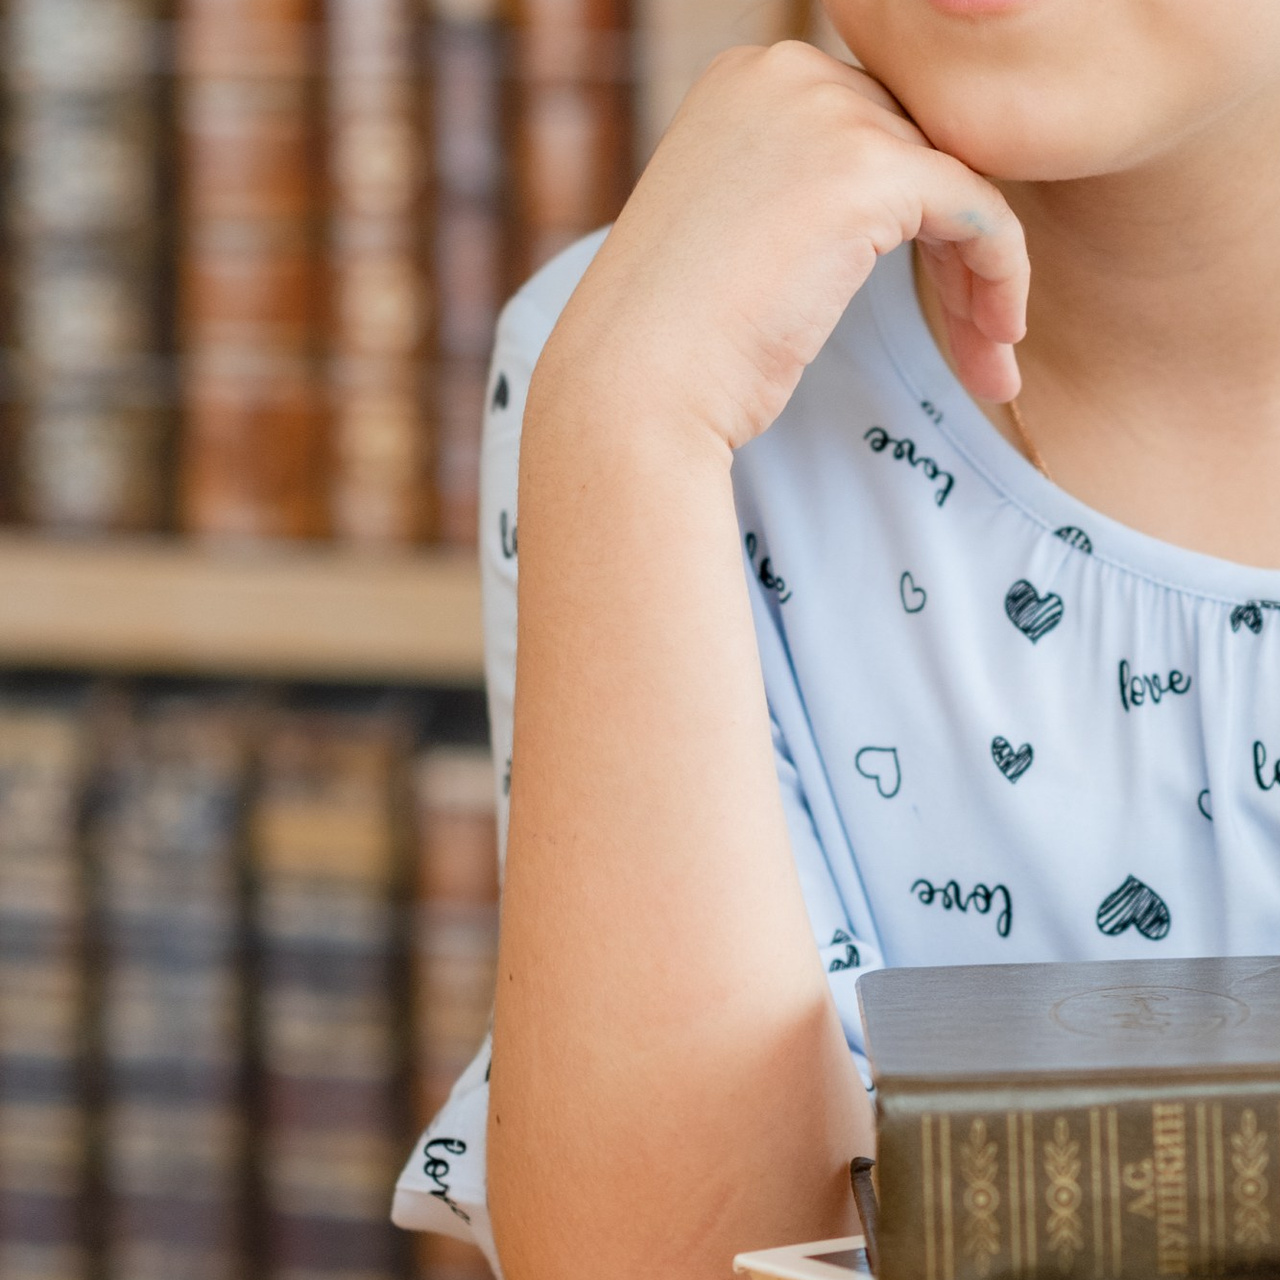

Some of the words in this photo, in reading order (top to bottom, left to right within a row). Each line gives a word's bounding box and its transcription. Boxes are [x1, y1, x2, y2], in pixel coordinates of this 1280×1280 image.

[863, 425, 955, 508] love
[1118, 658, 1192, 713] love
[910, 878, 1013, 939] love
[1152, 1101, 1189, 1274] ПУШКИН
